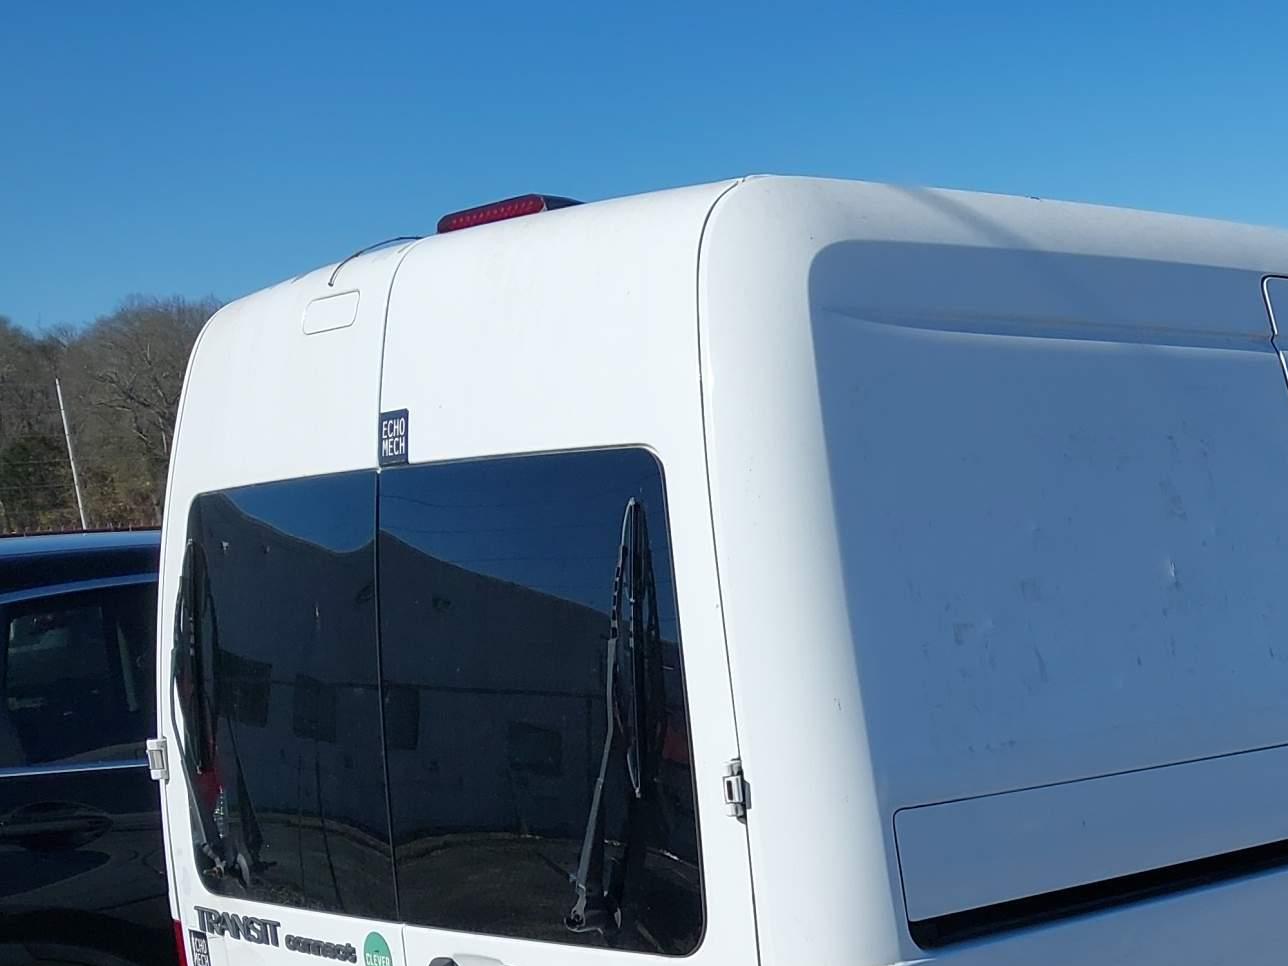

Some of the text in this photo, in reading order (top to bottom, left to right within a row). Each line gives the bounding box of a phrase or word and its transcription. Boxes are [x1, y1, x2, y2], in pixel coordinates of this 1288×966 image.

[382, 417, 406, 439] ECHO
[382, 436, 406, 457] MECH
[194, 905, 358, 964] TRANSIT connect
